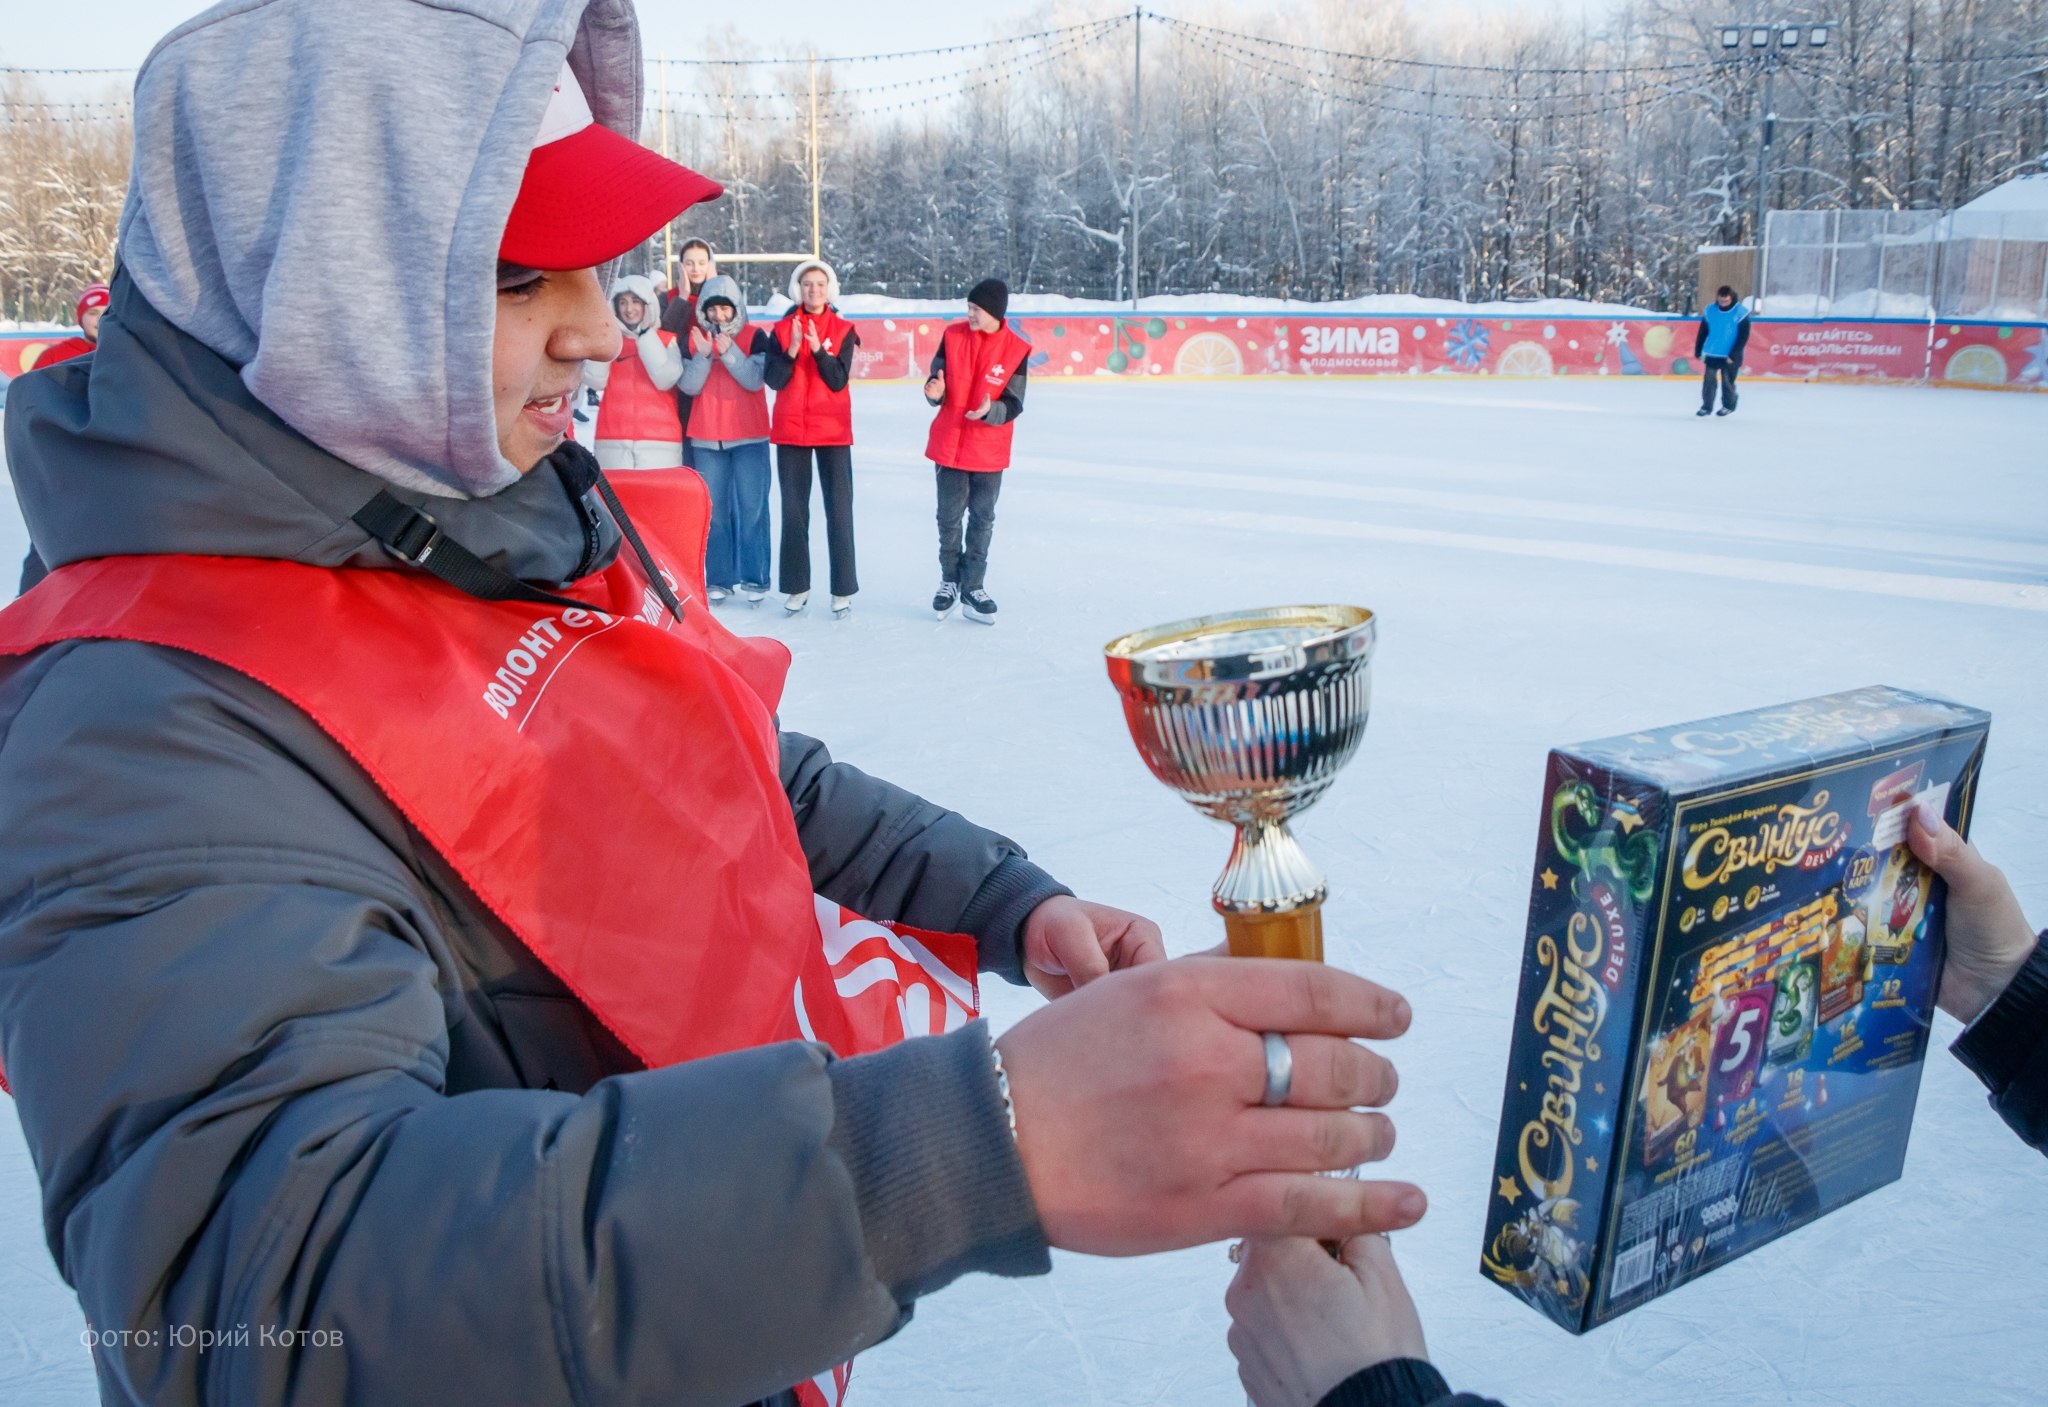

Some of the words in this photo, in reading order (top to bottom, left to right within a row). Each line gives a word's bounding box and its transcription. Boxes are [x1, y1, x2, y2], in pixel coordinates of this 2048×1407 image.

[1797, 328, 1873, 342] КАТАЙТЕСЬ
[1783, 344, 1902, 356] УДОВОЛЬСТВИЕМ!
[1804, 831, 1848, 867] DELUXE
[1852, 855, 1874, 877] 170
[1600, 892, 1624, 983] DELUXE
[1883, 979, 1901, 998] 12
[1720, 1008, 1760, 1072] 5
[1675, 1129, 1697, 1154] 60
